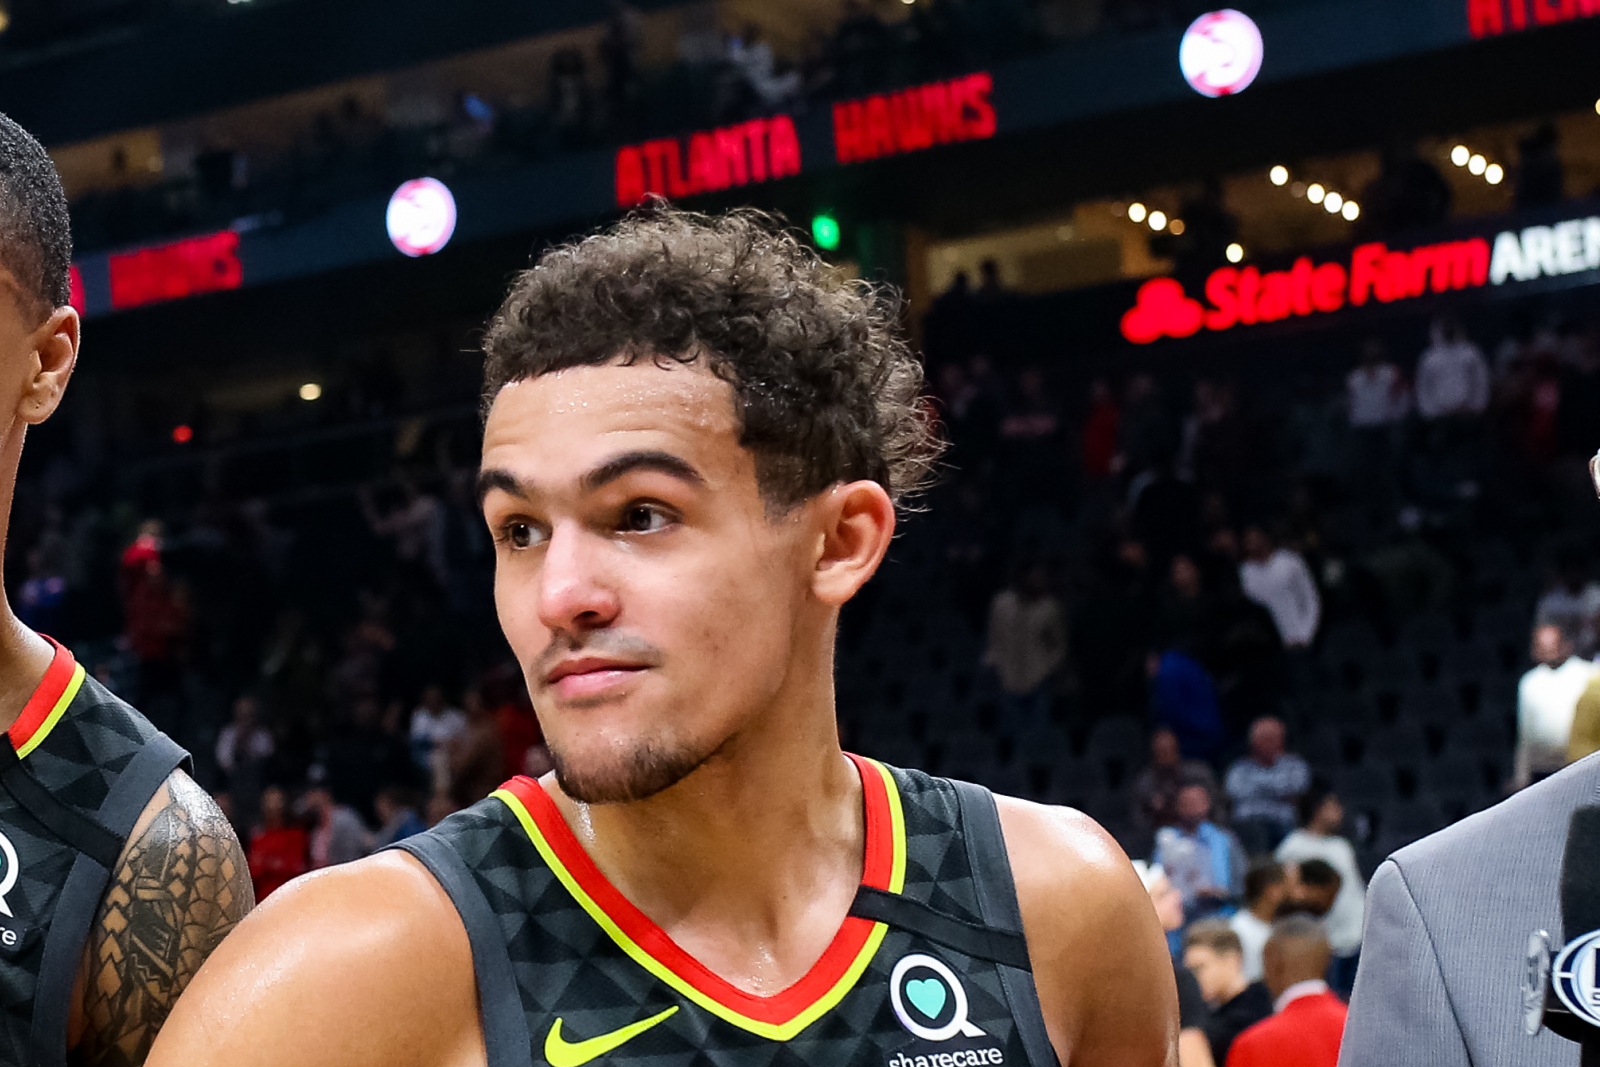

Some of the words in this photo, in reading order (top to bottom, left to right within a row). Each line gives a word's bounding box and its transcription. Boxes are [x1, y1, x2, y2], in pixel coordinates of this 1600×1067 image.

[616, 113, 800, 207] ATLANTA
[832, 71, 997, 164] HAWKS
[1204, 256, 1347, 331] State
[1349, 237, 1489, 306] Farm
